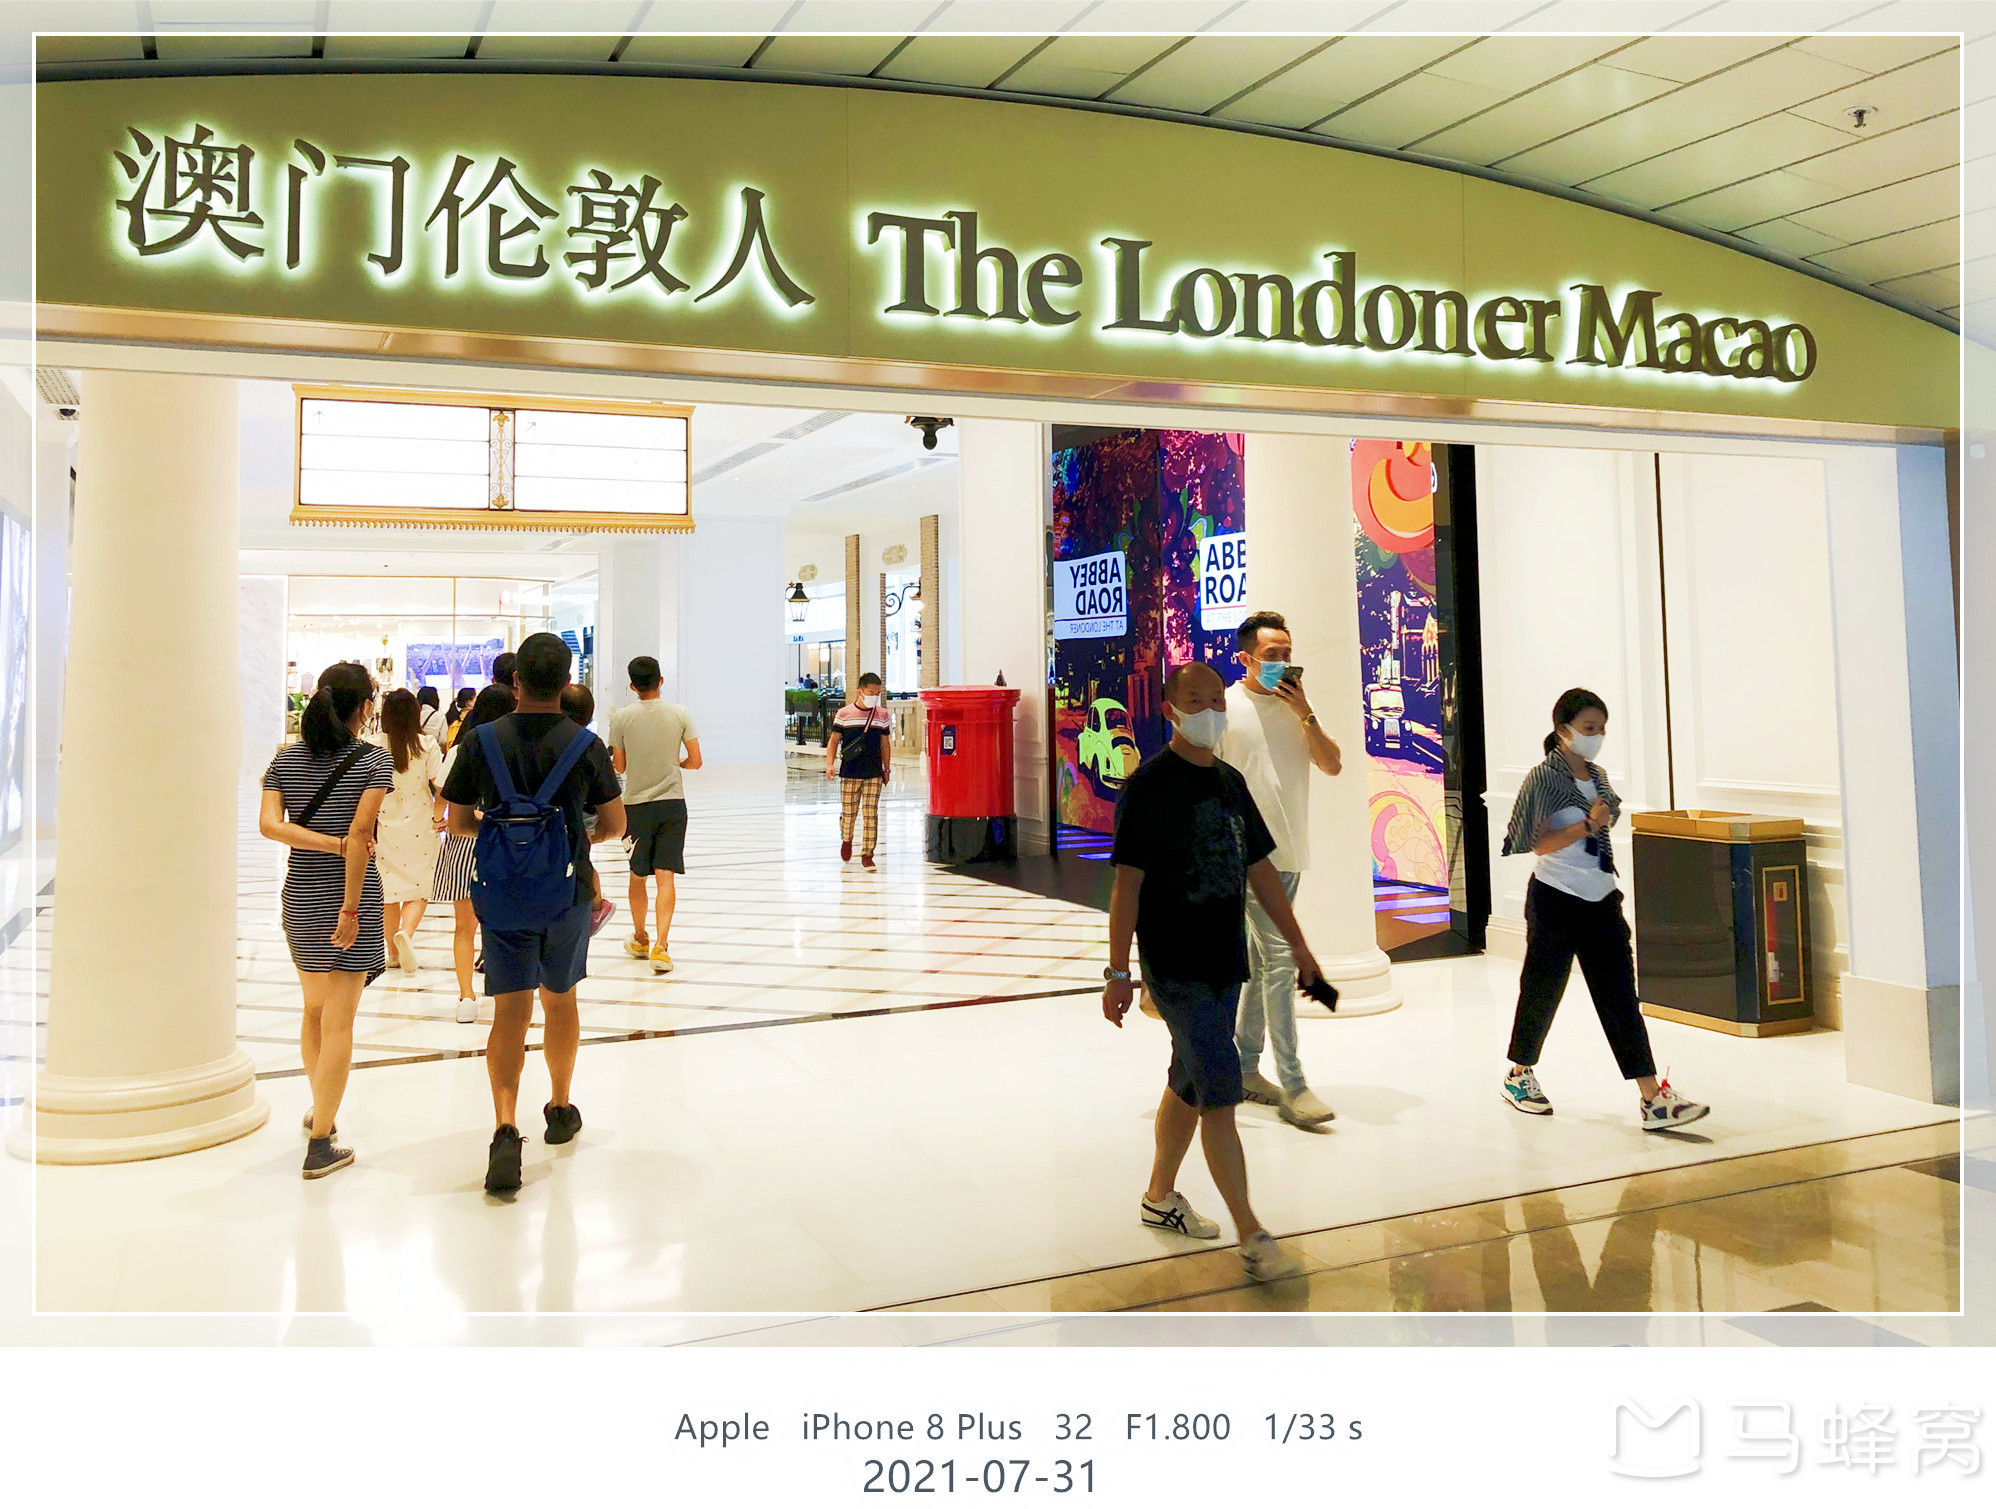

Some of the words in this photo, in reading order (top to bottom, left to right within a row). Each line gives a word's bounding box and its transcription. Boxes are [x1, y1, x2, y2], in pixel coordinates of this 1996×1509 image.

[114, 123, 815, 309] 澳门伦敦人
[867, 210, 1083, 327] The
[1101, 237, 1561, 363] Londoner
[1564, 283, 1818, 382] Macao
